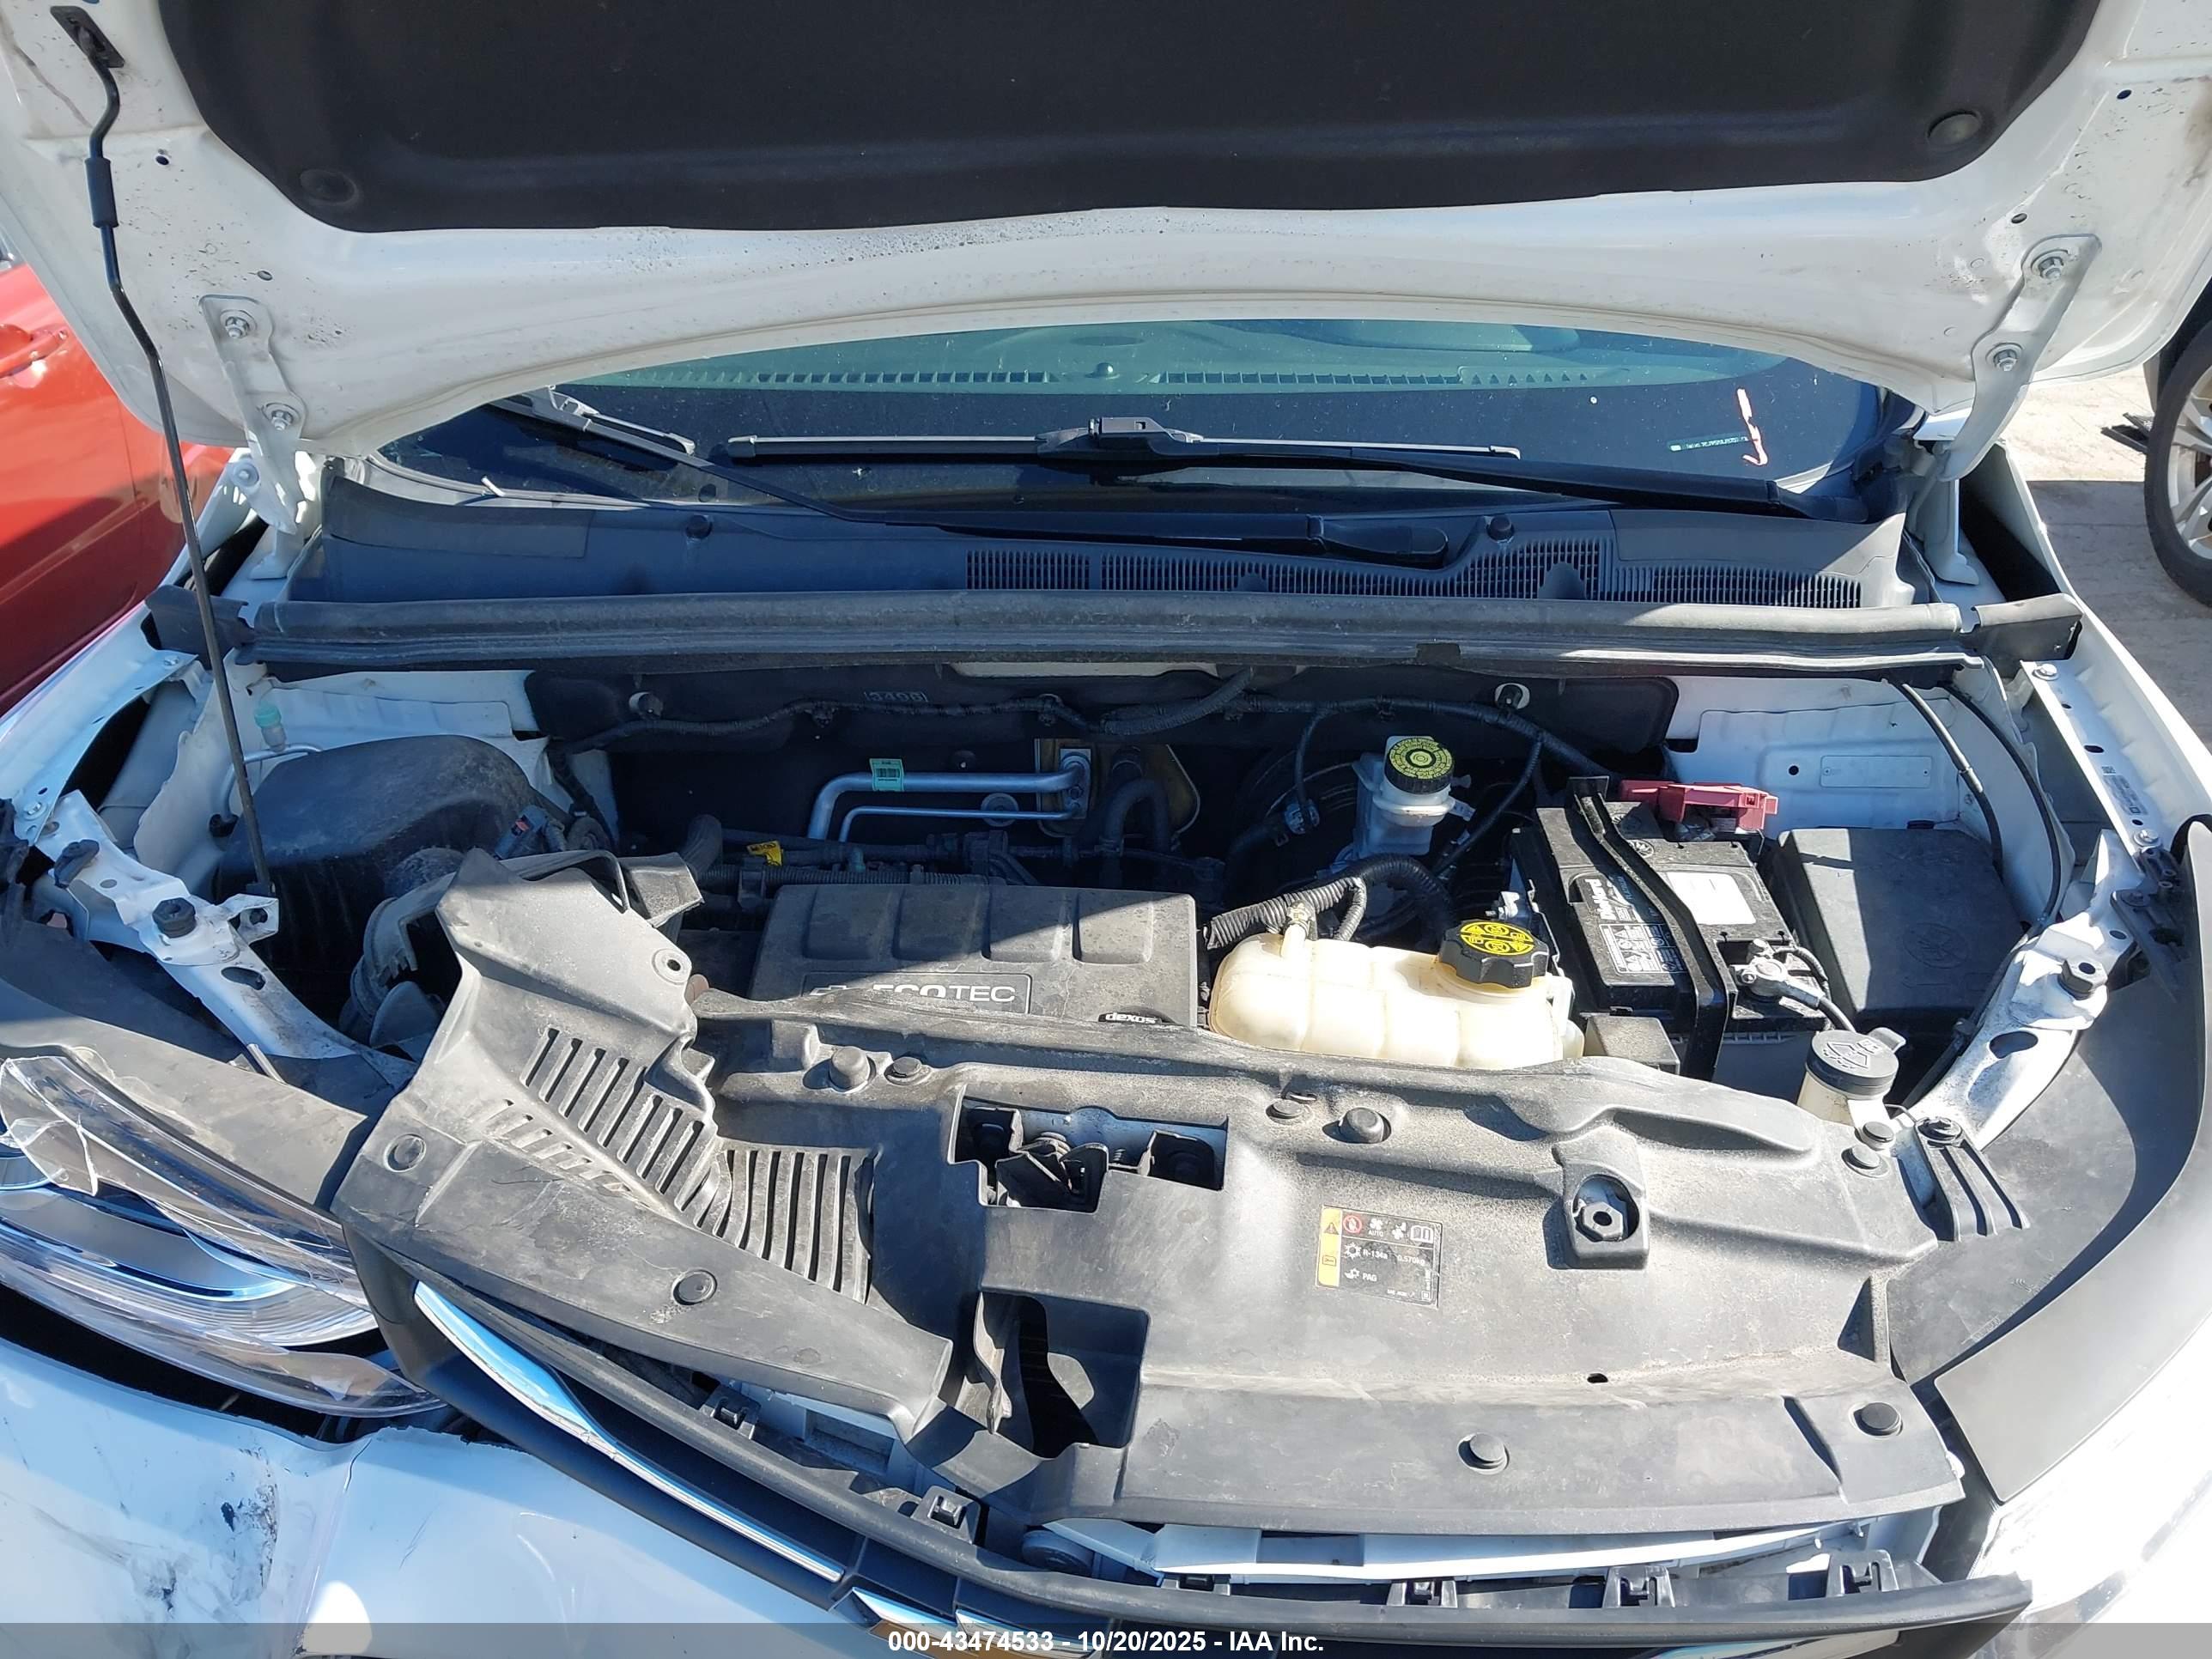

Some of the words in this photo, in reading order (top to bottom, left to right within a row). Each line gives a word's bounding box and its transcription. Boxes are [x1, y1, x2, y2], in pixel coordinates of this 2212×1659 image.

[1105, 1012, 1158, 1024] dexos
[1363, 1249, 1389, 1260] R-134a
[1362, 1272, 1377, 1282] PAG
